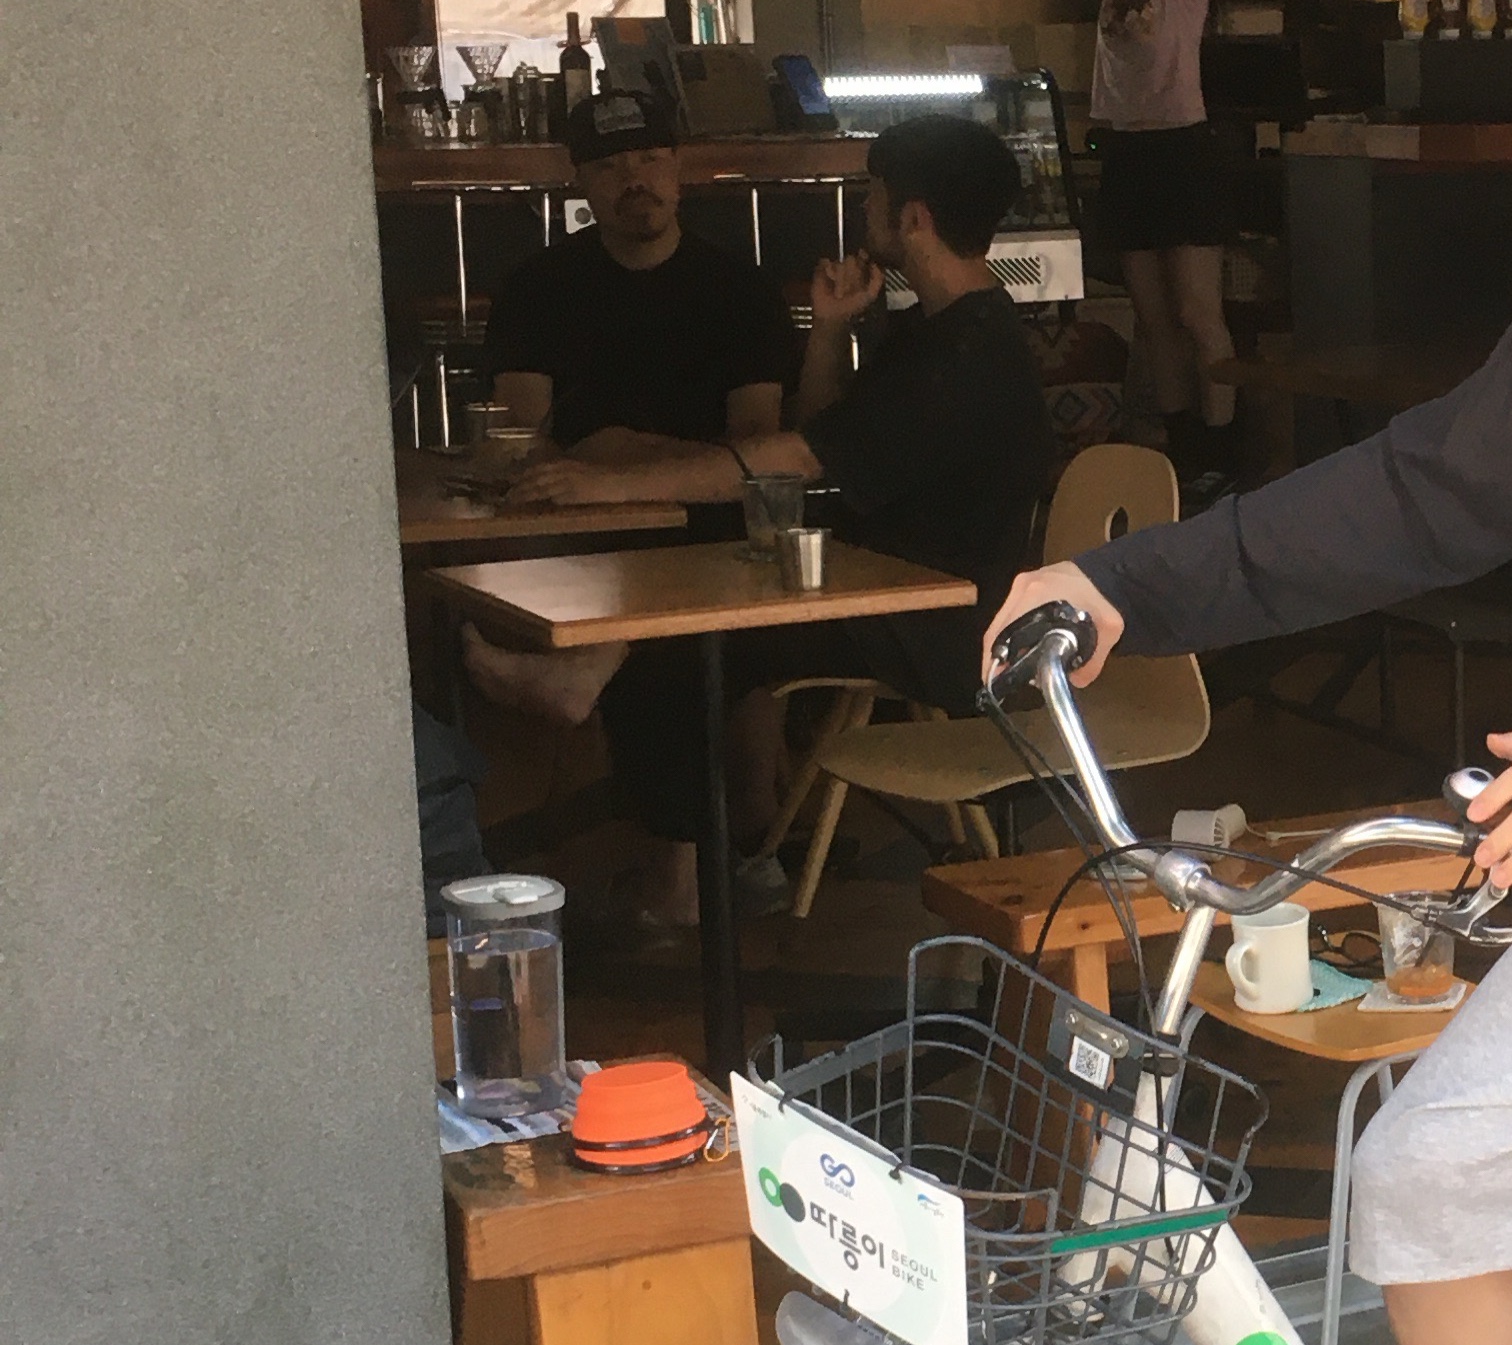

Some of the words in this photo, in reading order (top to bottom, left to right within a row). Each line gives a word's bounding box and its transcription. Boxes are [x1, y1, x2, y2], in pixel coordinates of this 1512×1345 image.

[809, 1200, 885, 1271] 따릉이
[891, 1249, 938, 1282] SEOUL
[892, 1265, 925, 1291] BIKE
